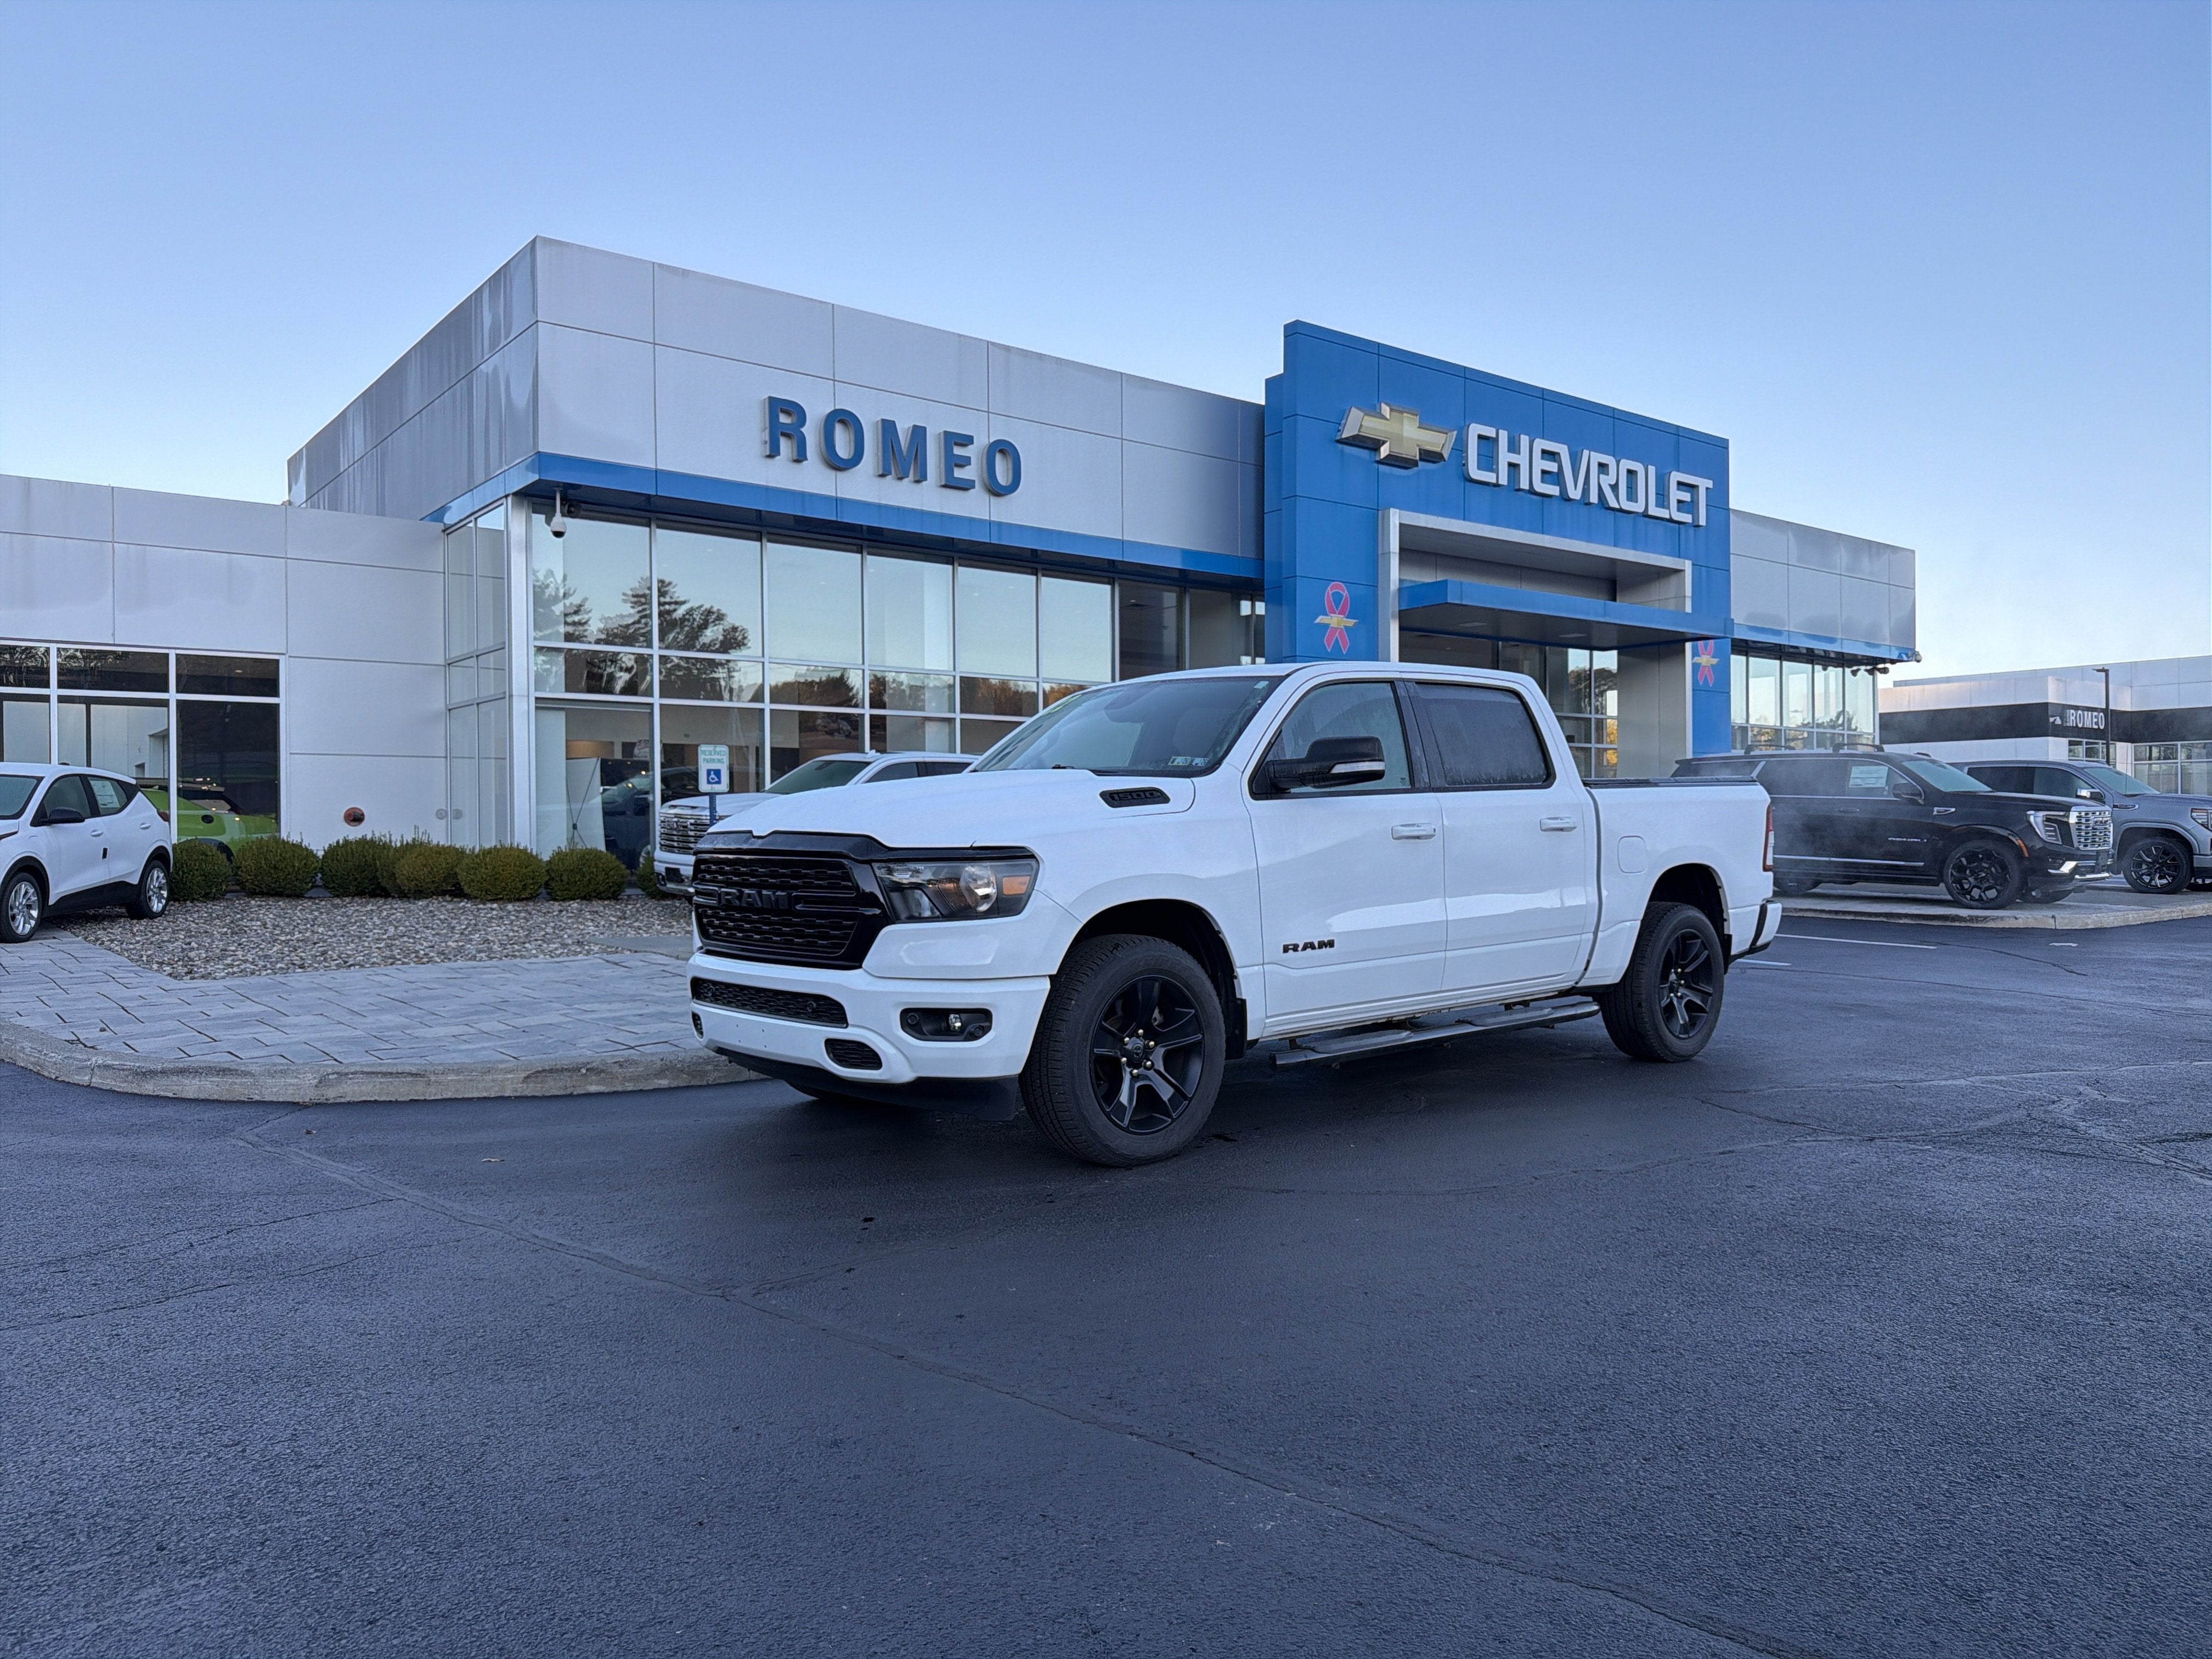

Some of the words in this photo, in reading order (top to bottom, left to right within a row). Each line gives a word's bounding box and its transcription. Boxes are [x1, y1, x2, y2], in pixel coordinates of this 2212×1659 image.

[765, 396, 1022, 496] ROMEO
[1463, 422, 1713, 527] CHEVROLET
[2068, 709, 2105, 730] ROMEO
[1109, 791, 1156, 800] 1500
[720, 888, 789, 909] RAM
[1282, 939, 1335, 954] RAM
